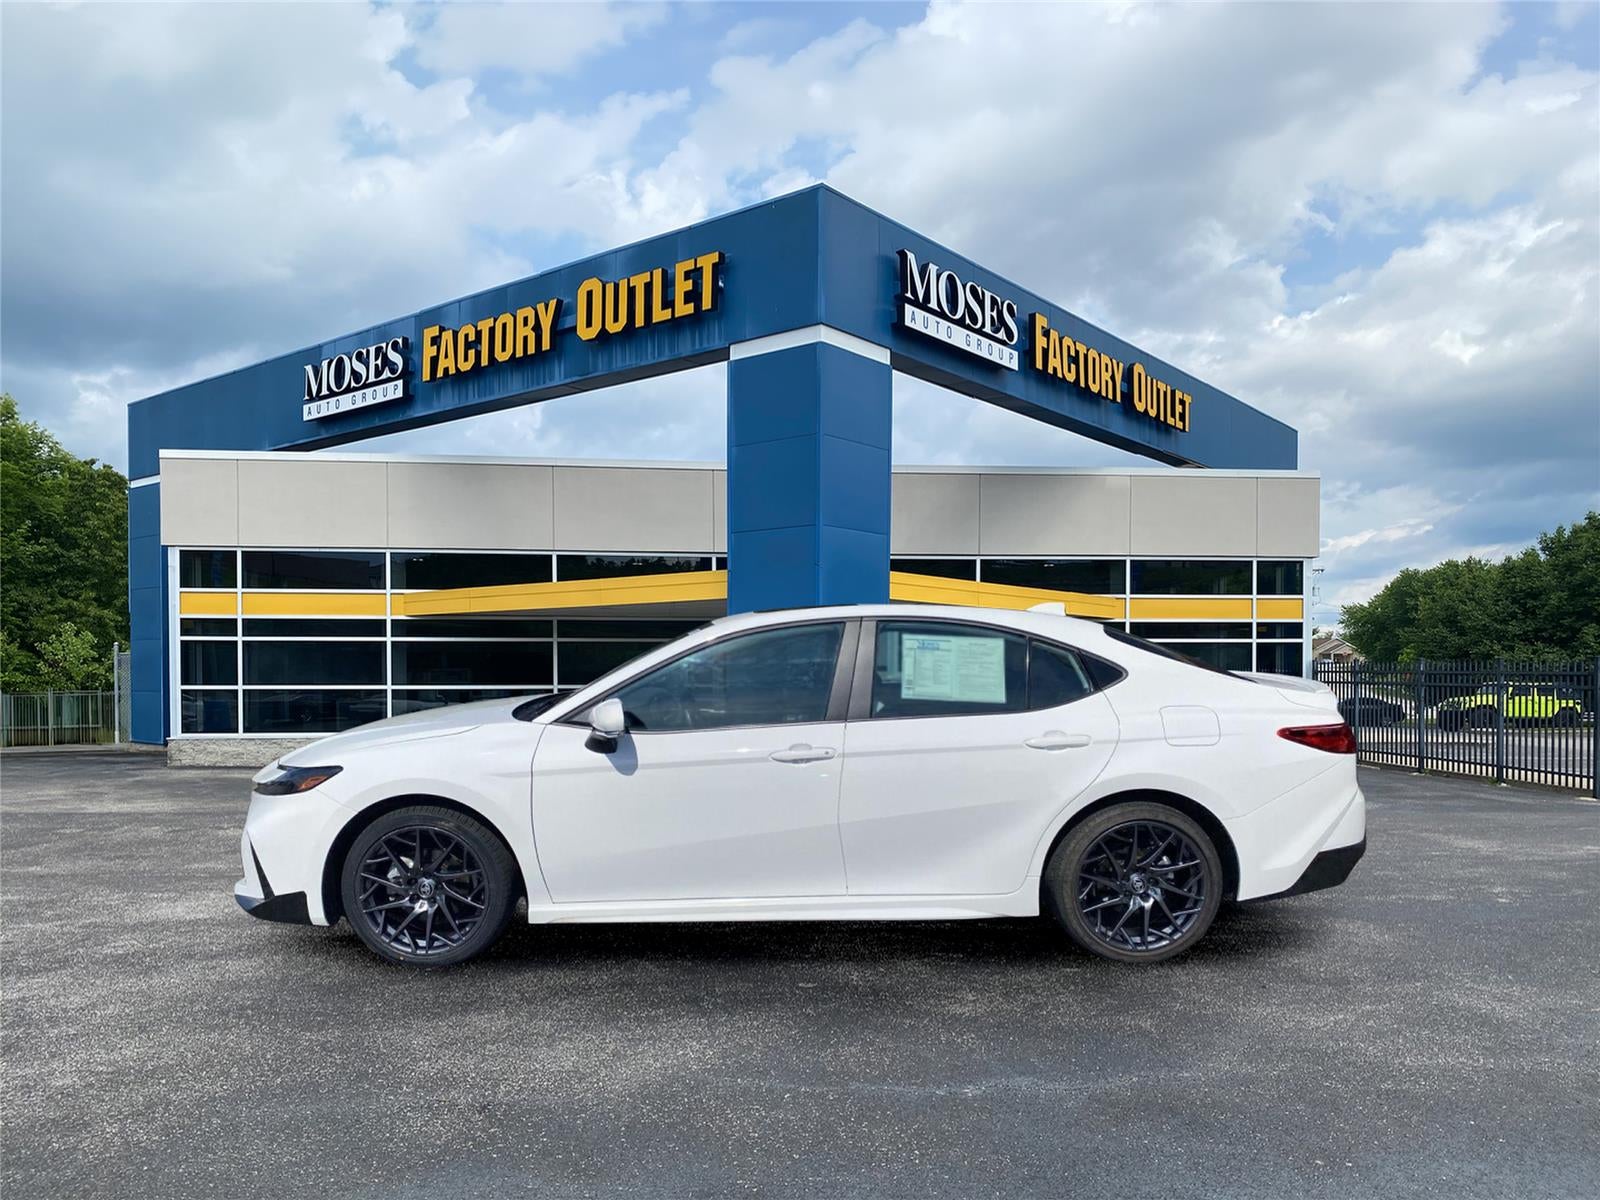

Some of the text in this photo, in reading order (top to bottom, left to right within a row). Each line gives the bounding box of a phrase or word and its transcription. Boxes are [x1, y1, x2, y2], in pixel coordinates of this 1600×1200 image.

[422, 251, 720, 382] FACTORY OUTLET
[904, 249, 1018, 345] MOSES
[910, 310, 1015, 364] AUTO GROUP
[303, 337, 404, 401] MOSES
[307, 383, 399, 417] AUTO GROUP
[1034, 312, 1192, 433] FACTORY OUTLET
